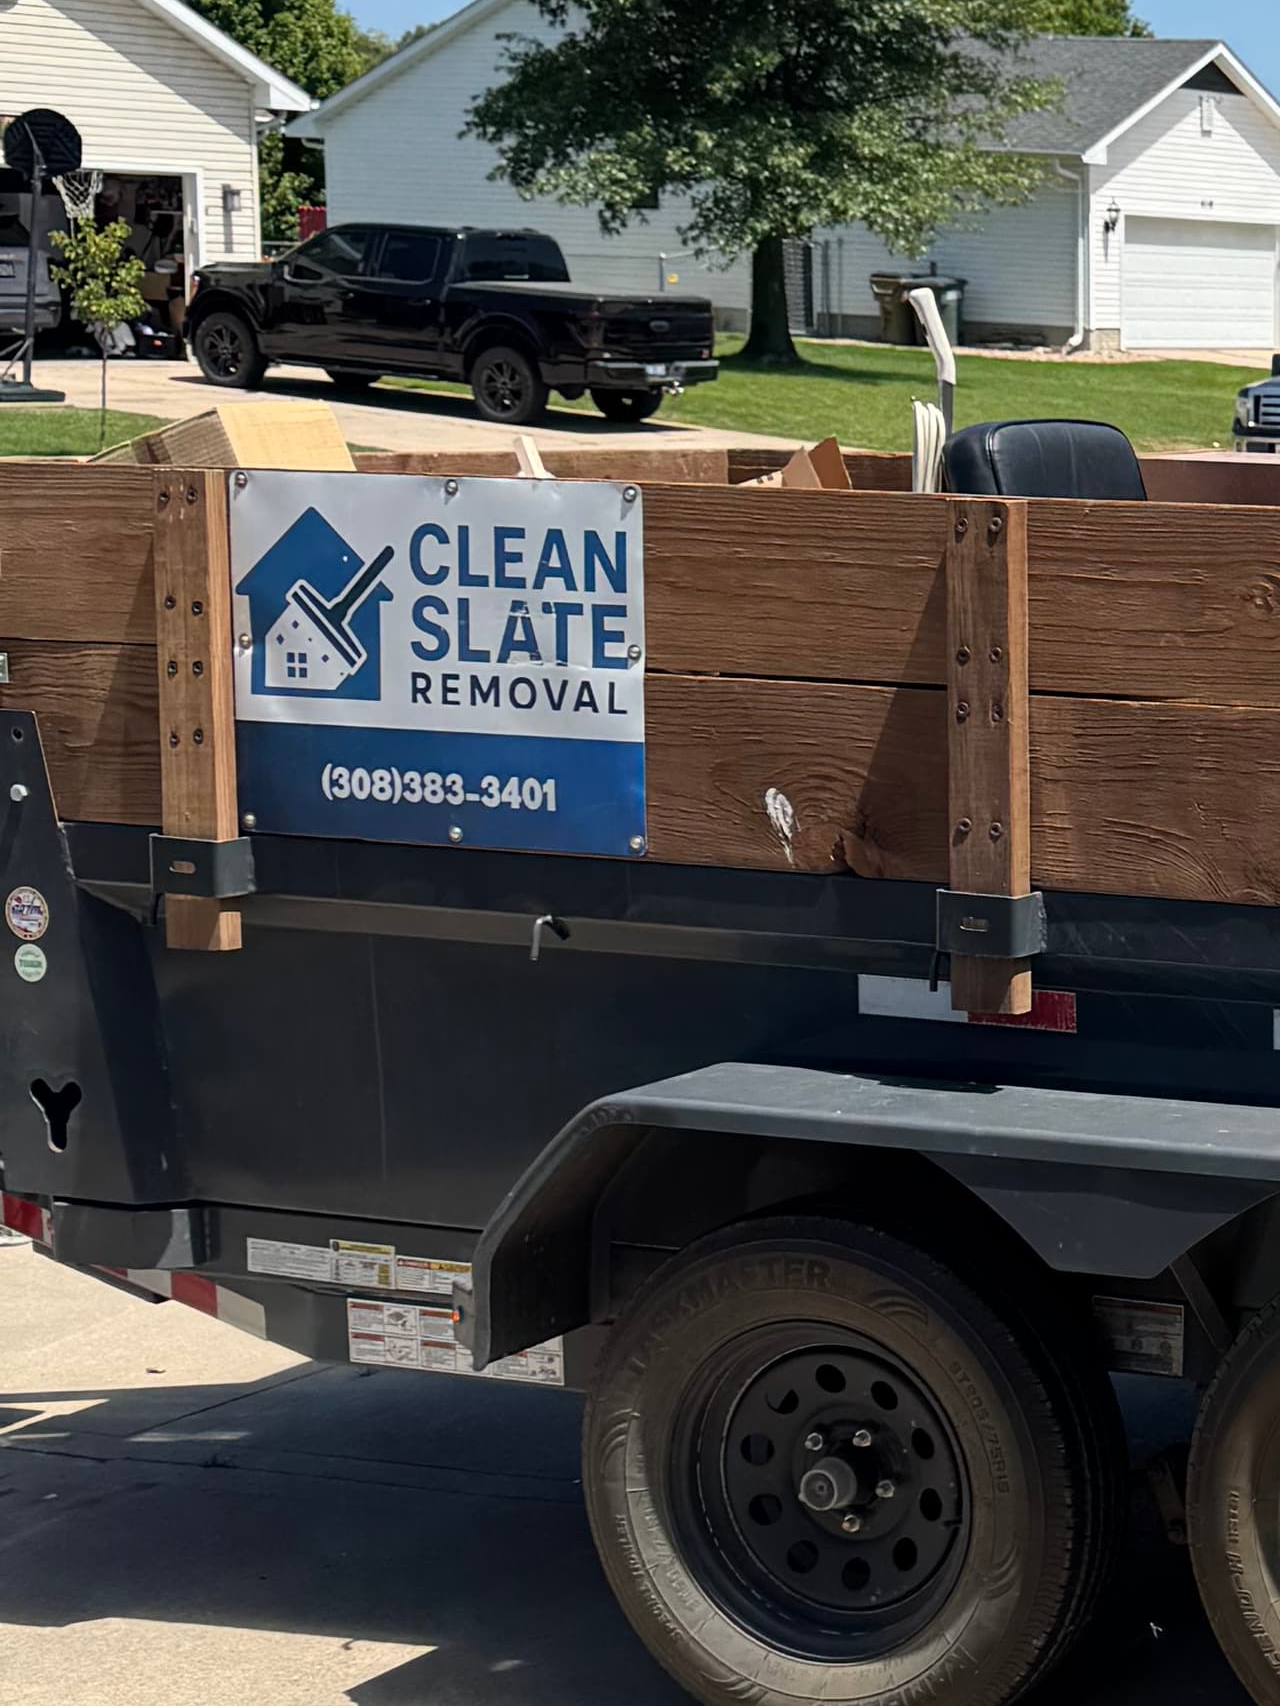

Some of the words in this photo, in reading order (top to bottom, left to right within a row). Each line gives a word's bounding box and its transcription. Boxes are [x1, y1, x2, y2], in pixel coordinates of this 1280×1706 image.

[409, 523, 628, 594] CLEAN
[410, 595, 629, 670] SLATE
[410, 672, 629, 715] REMOVAL
[321, 763, 557, 812] (308)383-3401
